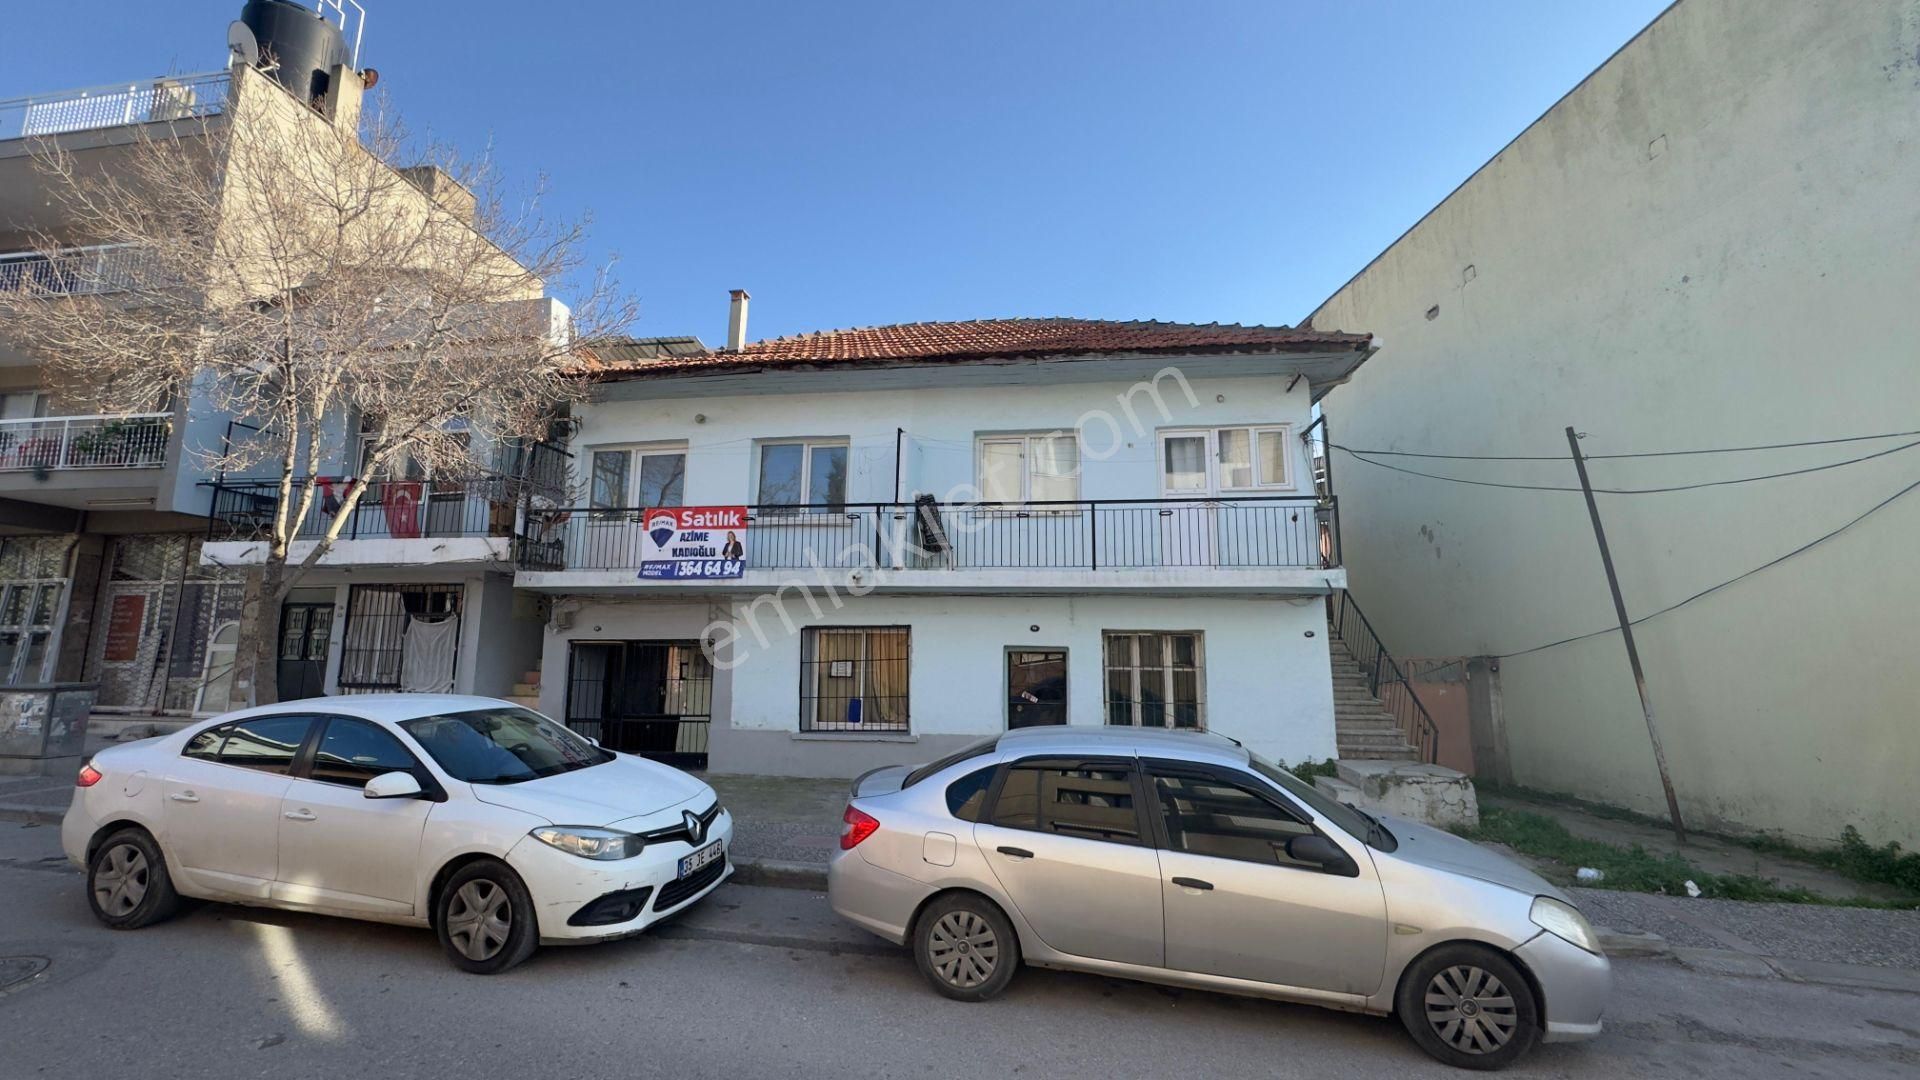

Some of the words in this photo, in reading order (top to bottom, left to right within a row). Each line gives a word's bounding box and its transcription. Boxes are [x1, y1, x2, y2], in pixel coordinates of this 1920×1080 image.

[681, 510, 740, 527] Satılık
[680, 530, 709, 542] AZİME
[672, 545, 716, 558] KADIOĞLU
[704, 561, 722, 576] 64
[722, 561, 741, 575] 94
[684, 858, 693, 874] 35
[696, 851, 705, 867] JE
